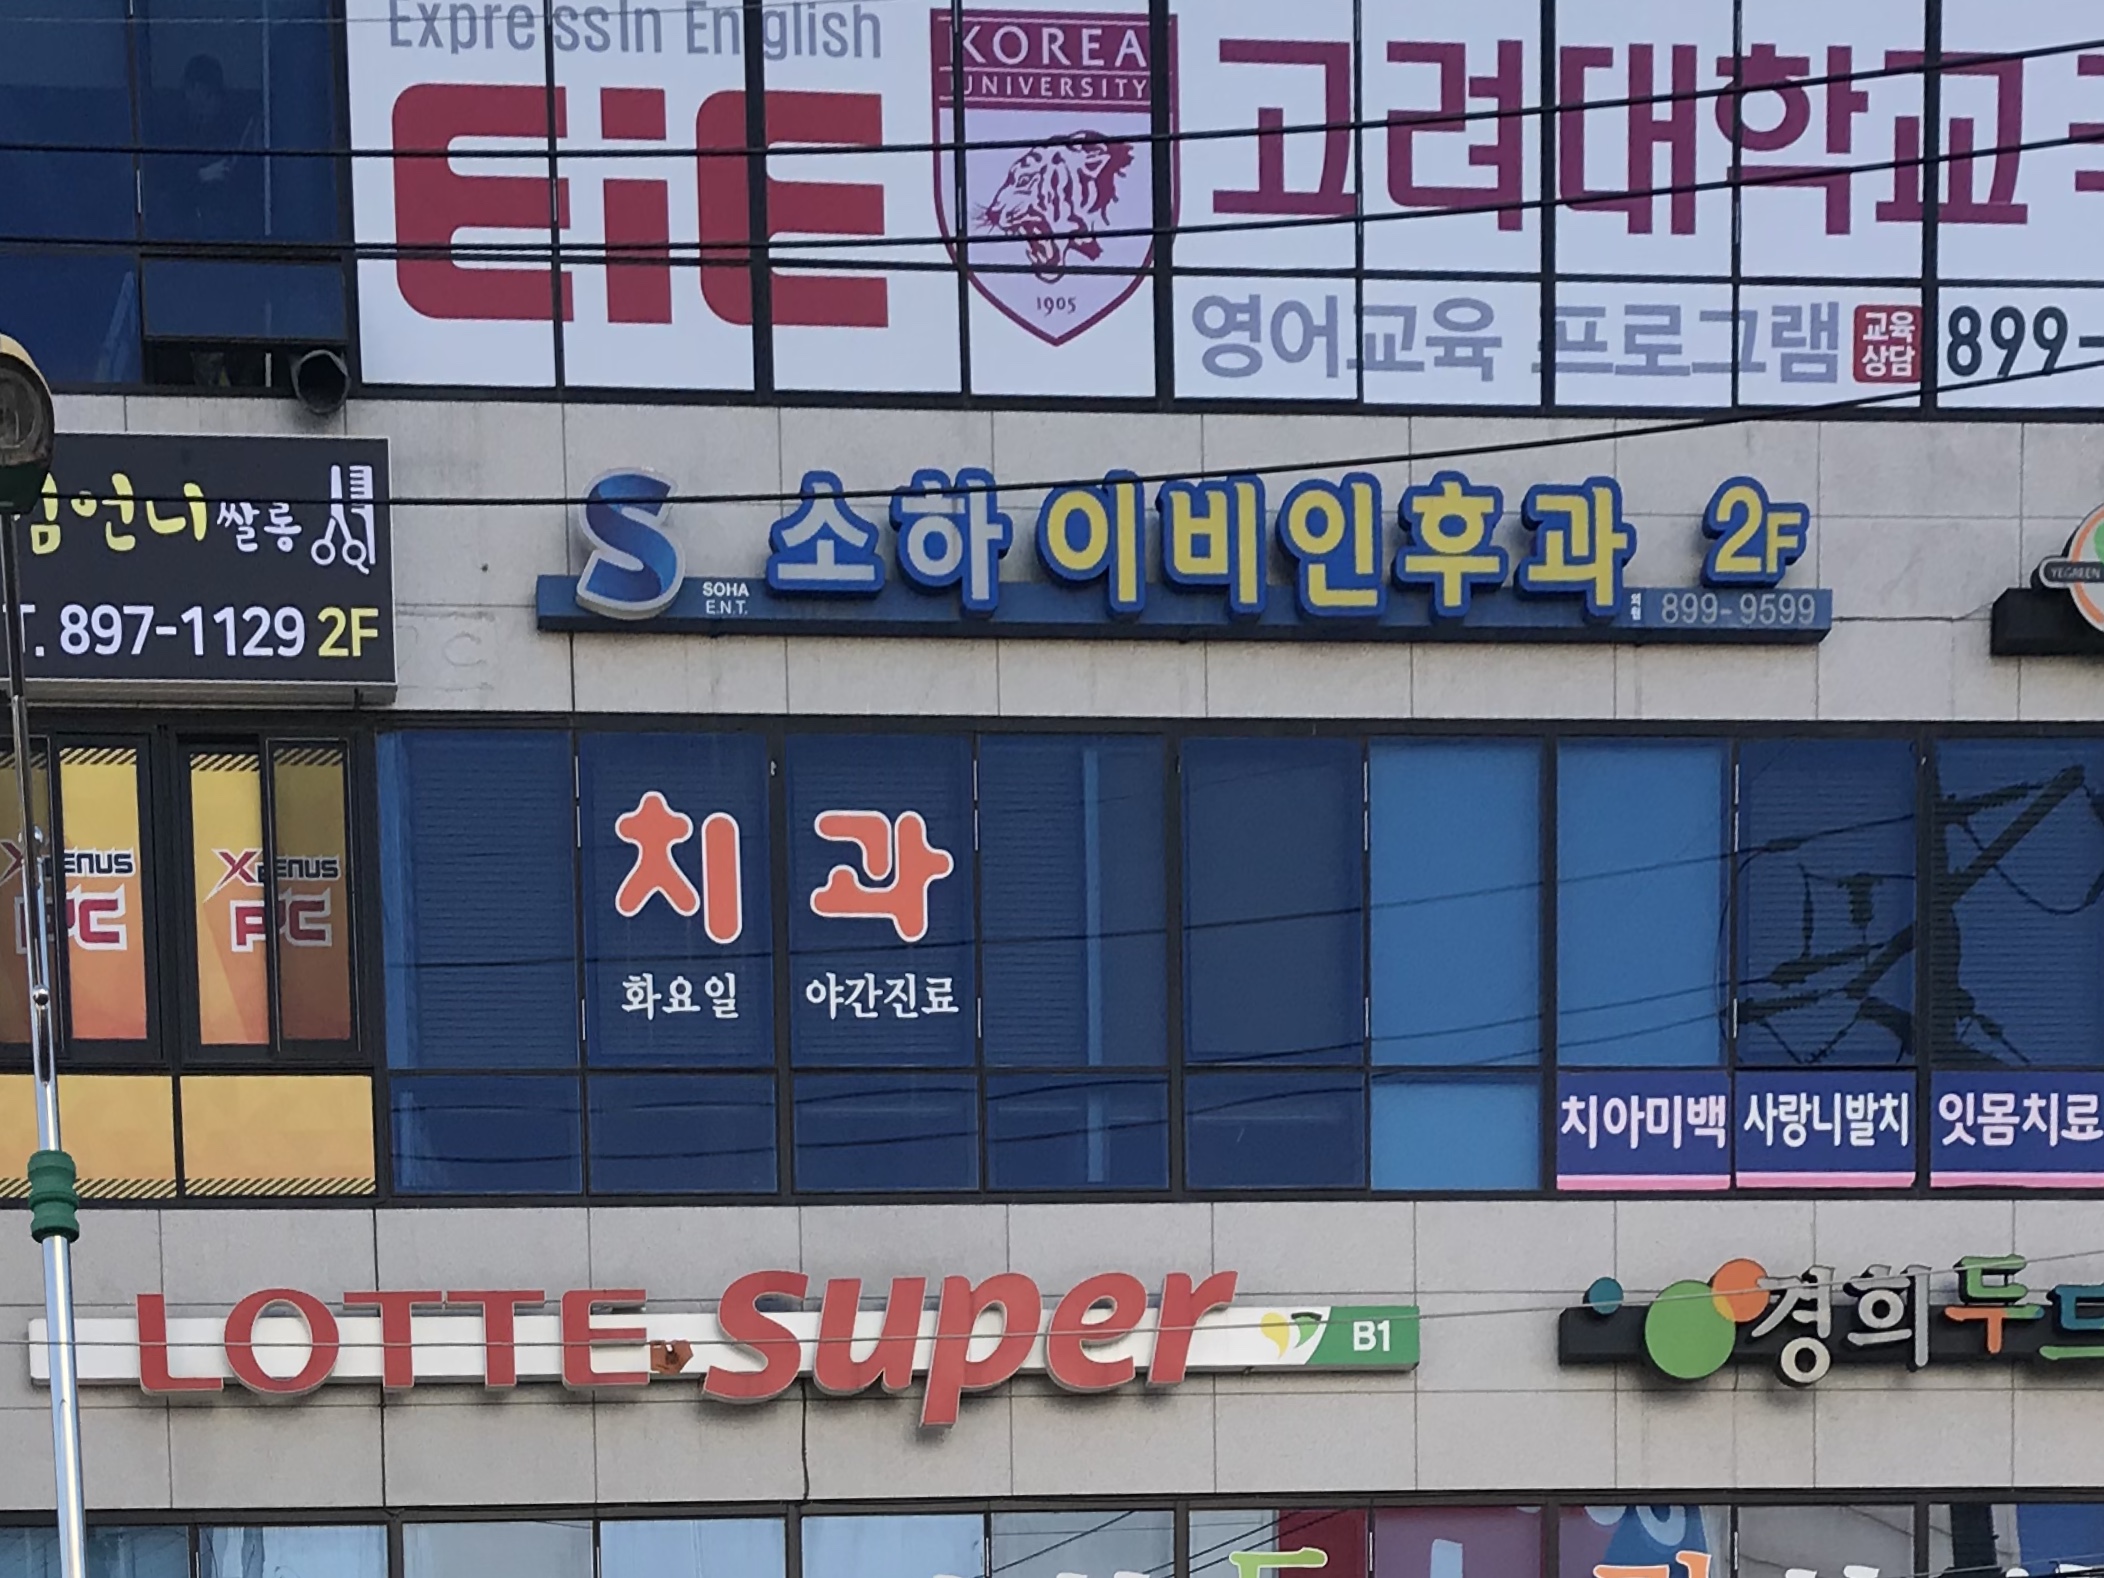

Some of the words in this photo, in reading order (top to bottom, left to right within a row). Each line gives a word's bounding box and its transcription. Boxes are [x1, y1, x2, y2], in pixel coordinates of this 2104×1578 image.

[686, 0, 881, 61] English
[949, 25, 1148, 68] KOREA
[950, 75, 1147, 99] UNIVERSITY
[1036, 295, 1077, 317] 1905
[1862, 310, 1916, 344] 교육
[1192, 294, 1502, 382] 영어교육
[1531, 302, 1840, 383] 프로그램
[1862, 345, 1916, 377] 상담
[1704, 476, 1810, 586] 2F
[702, 582, 750, 597] SOHA
[1661, 592, 1816, 625] 899-9599
[318, 608, 379, 657] 2F
[229, 887, 332, 952] PC
[621, 973, 740, 1020] 화요일
[805, 972, 960, 1020] 야간진료
[1560, 1094, 1727, 1149] 치아미백
[1743, 1092, 1909, 1148] 사랑니발치
[1937, 1091, 2104, 1147] 잇몸치료
[136, 1287, 650, 1395] LOTTE
[1353, 1319, 1390, 1352] B1
